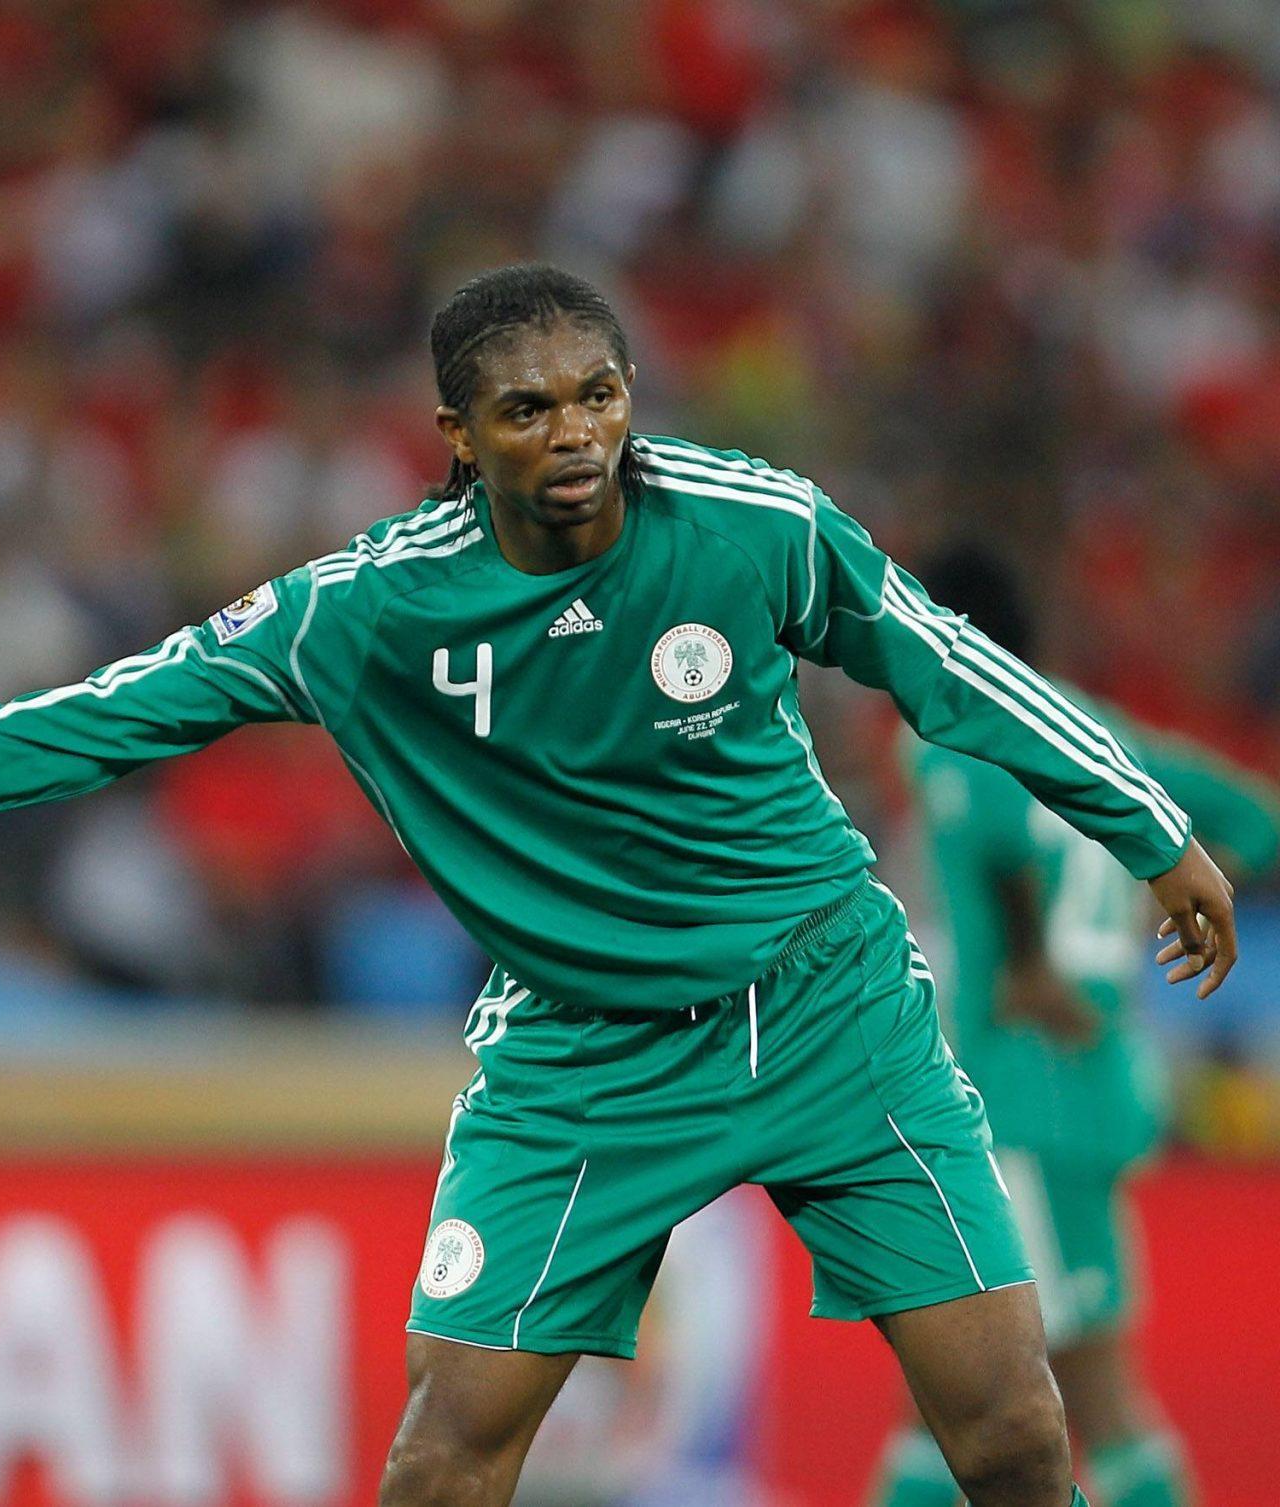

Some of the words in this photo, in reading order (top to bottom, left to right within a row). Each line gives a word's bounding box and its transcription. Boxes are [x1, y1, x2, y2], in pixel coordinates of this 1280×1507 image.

[548, 619, 604, 638] adidas
[658, 626, 700, 651] FOOTBALL
[702, 628, 731, 674] FEDERATION
[653, 651, 668, 688] NIGERIA
[432, 643, 493, 737] 4
[683, 690, 712, 699] ABUJA
[654, 718, 681, 730] NIGERIA
[687, 712, 711, 723] KOREA
[711, 701, 741, 718] REPUBLIC
[677, 724, 695, 735] JUNE
[465, 1231, 483, 1284] FEDERATION
